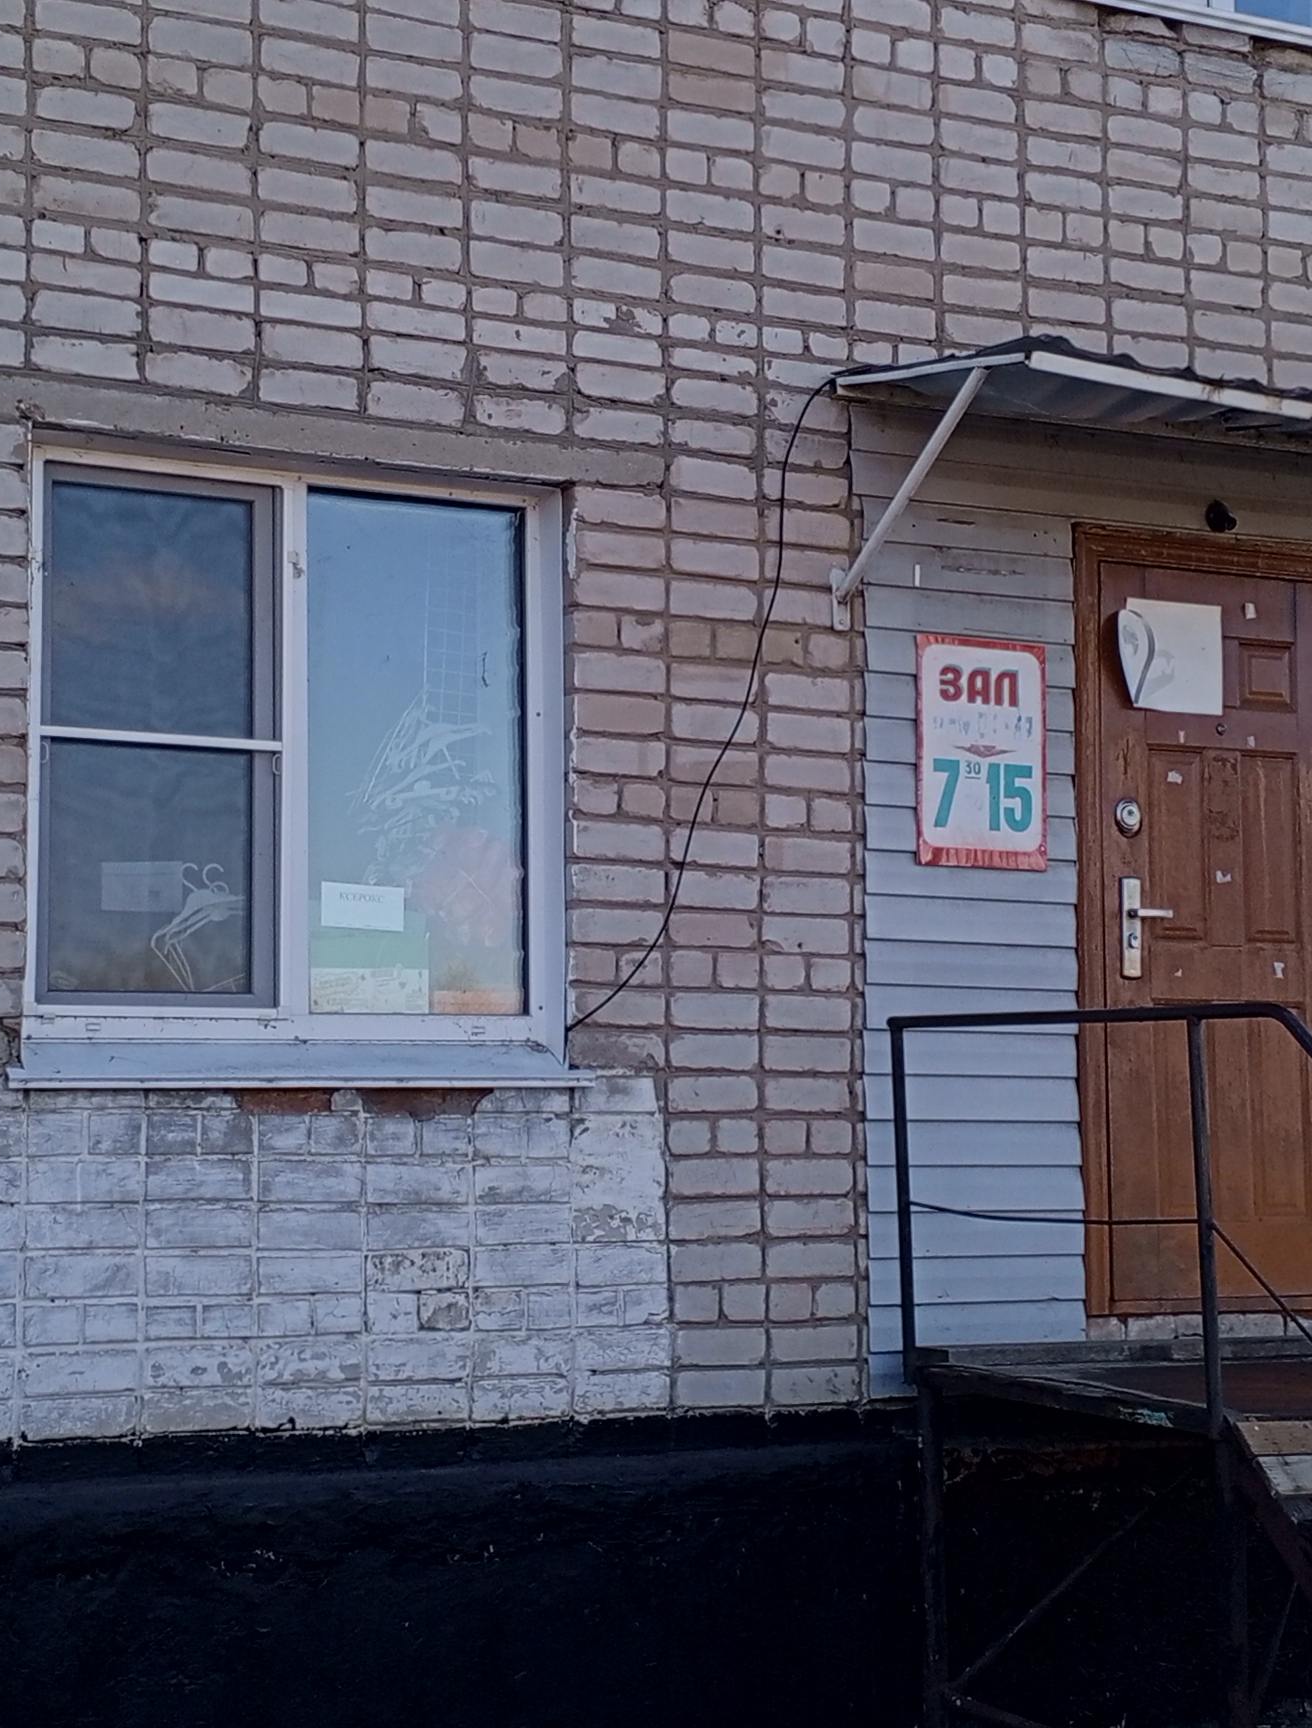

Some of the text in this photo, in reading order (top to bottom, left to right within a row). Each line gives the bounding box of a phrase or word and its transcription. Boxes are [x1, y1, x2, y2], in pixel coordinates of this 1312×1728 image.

[938, 663, 1020, 708] ЗАЛ
[933, 757, 1033, 833] 7 30 15
[339, 891, 385, 903] КСЕРОКС
